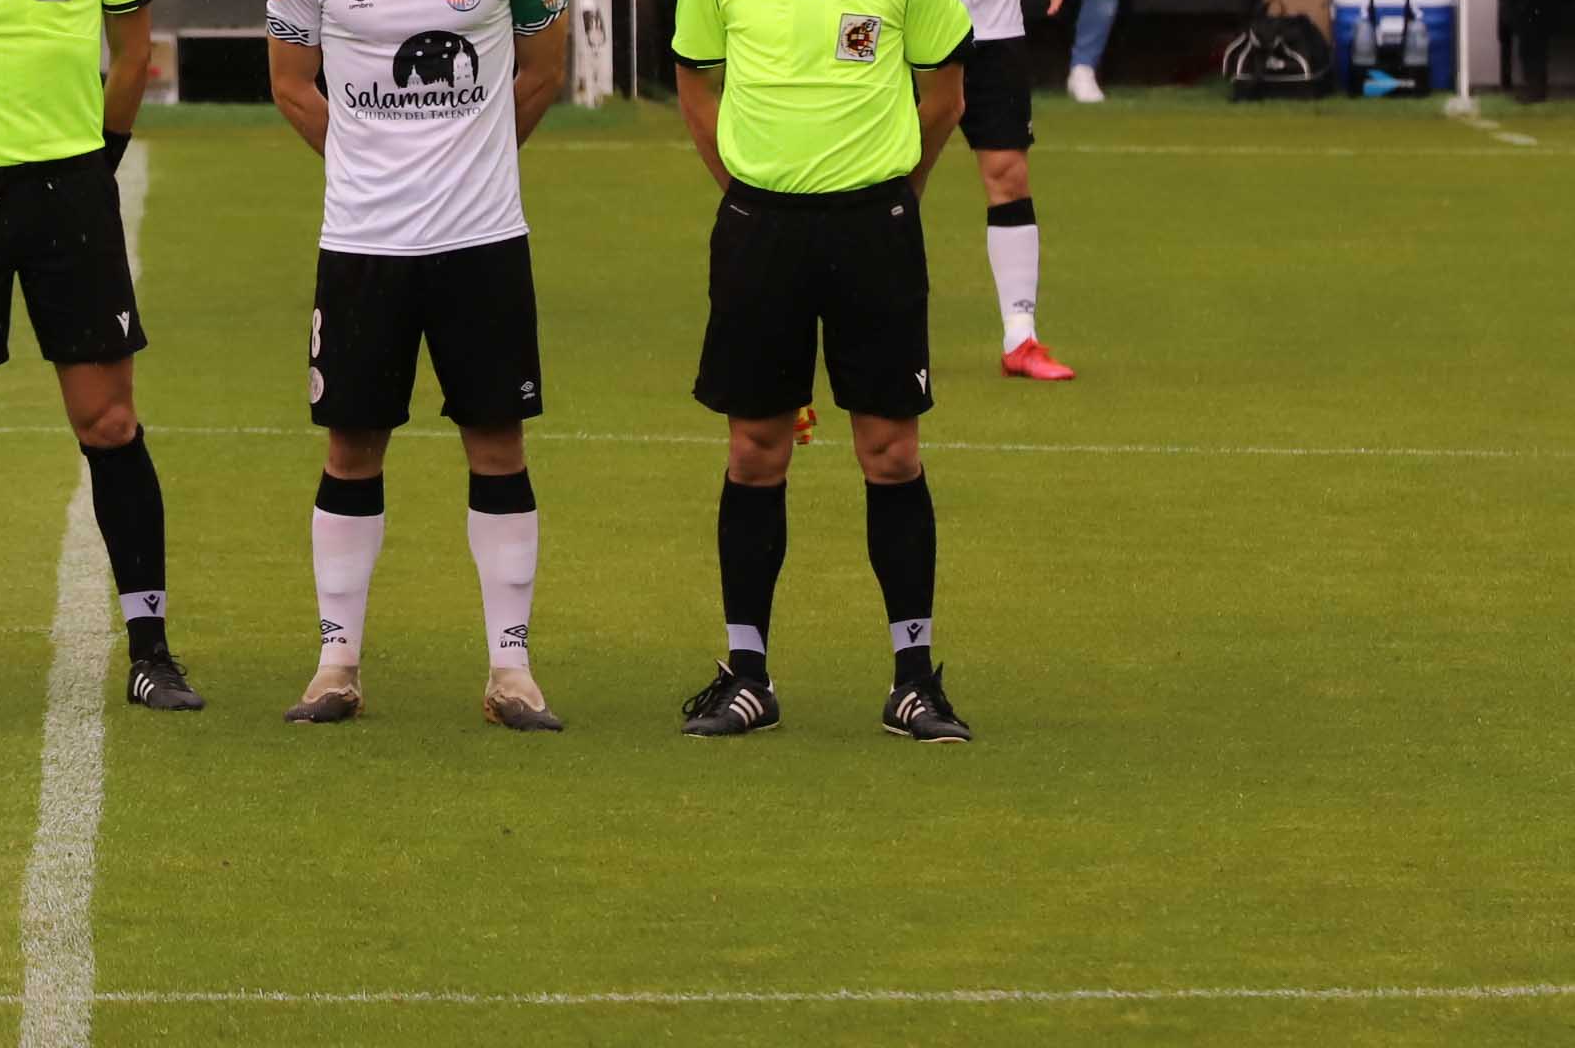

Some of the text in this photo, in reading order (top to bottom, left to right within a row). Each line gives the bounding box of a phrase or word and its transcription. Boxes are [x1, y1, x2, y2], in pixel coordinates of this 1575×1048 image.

[344, 81, 489, 110] Salamanca
[405, 110, 426, 120] DEL
[311, 307, 323, 359] 8
